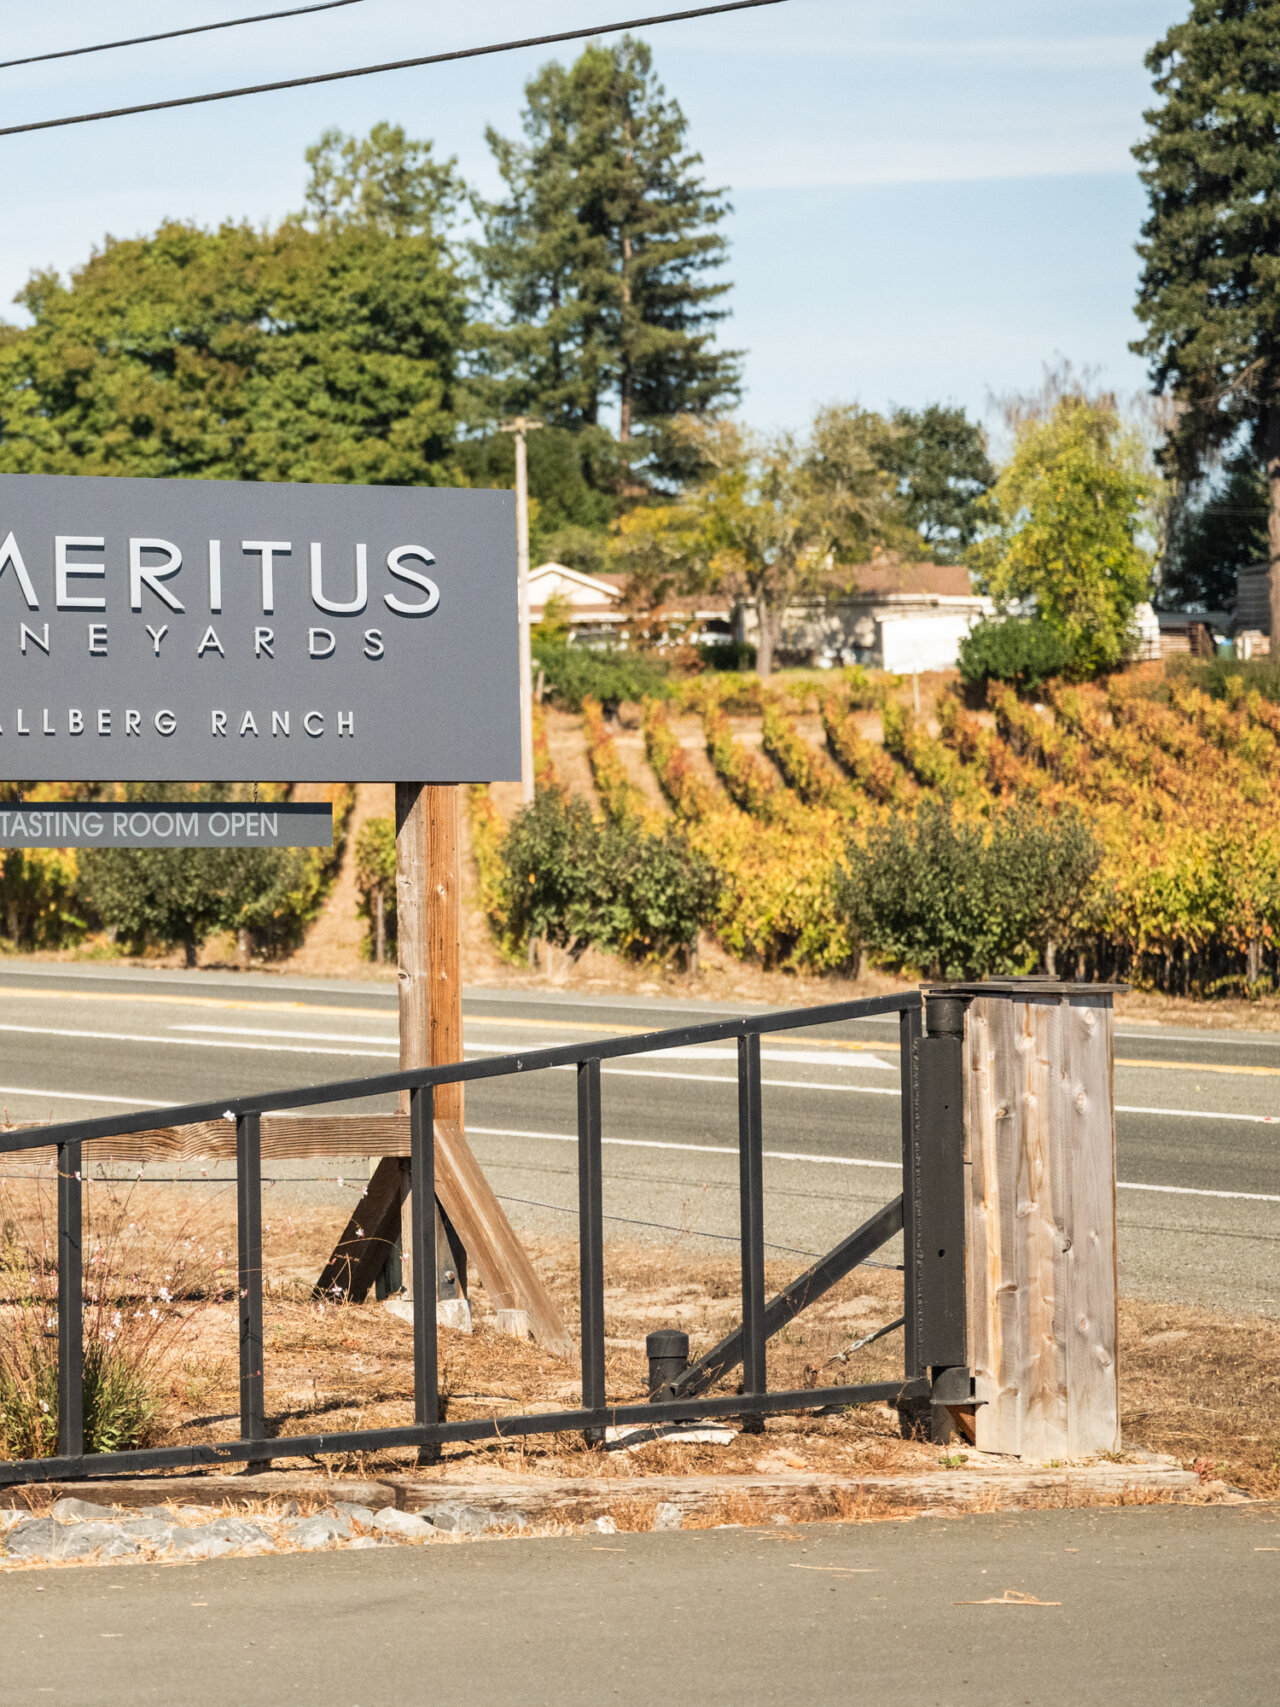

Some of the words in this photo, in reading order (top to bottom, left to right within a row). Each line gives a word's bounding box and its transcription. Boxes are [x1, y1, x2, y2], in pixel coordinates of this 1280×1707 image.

[210, 709, 355, 736] RANCH
[113, 811, 199, 838] ROOM
[207, 811, 279, 838] OPEN
